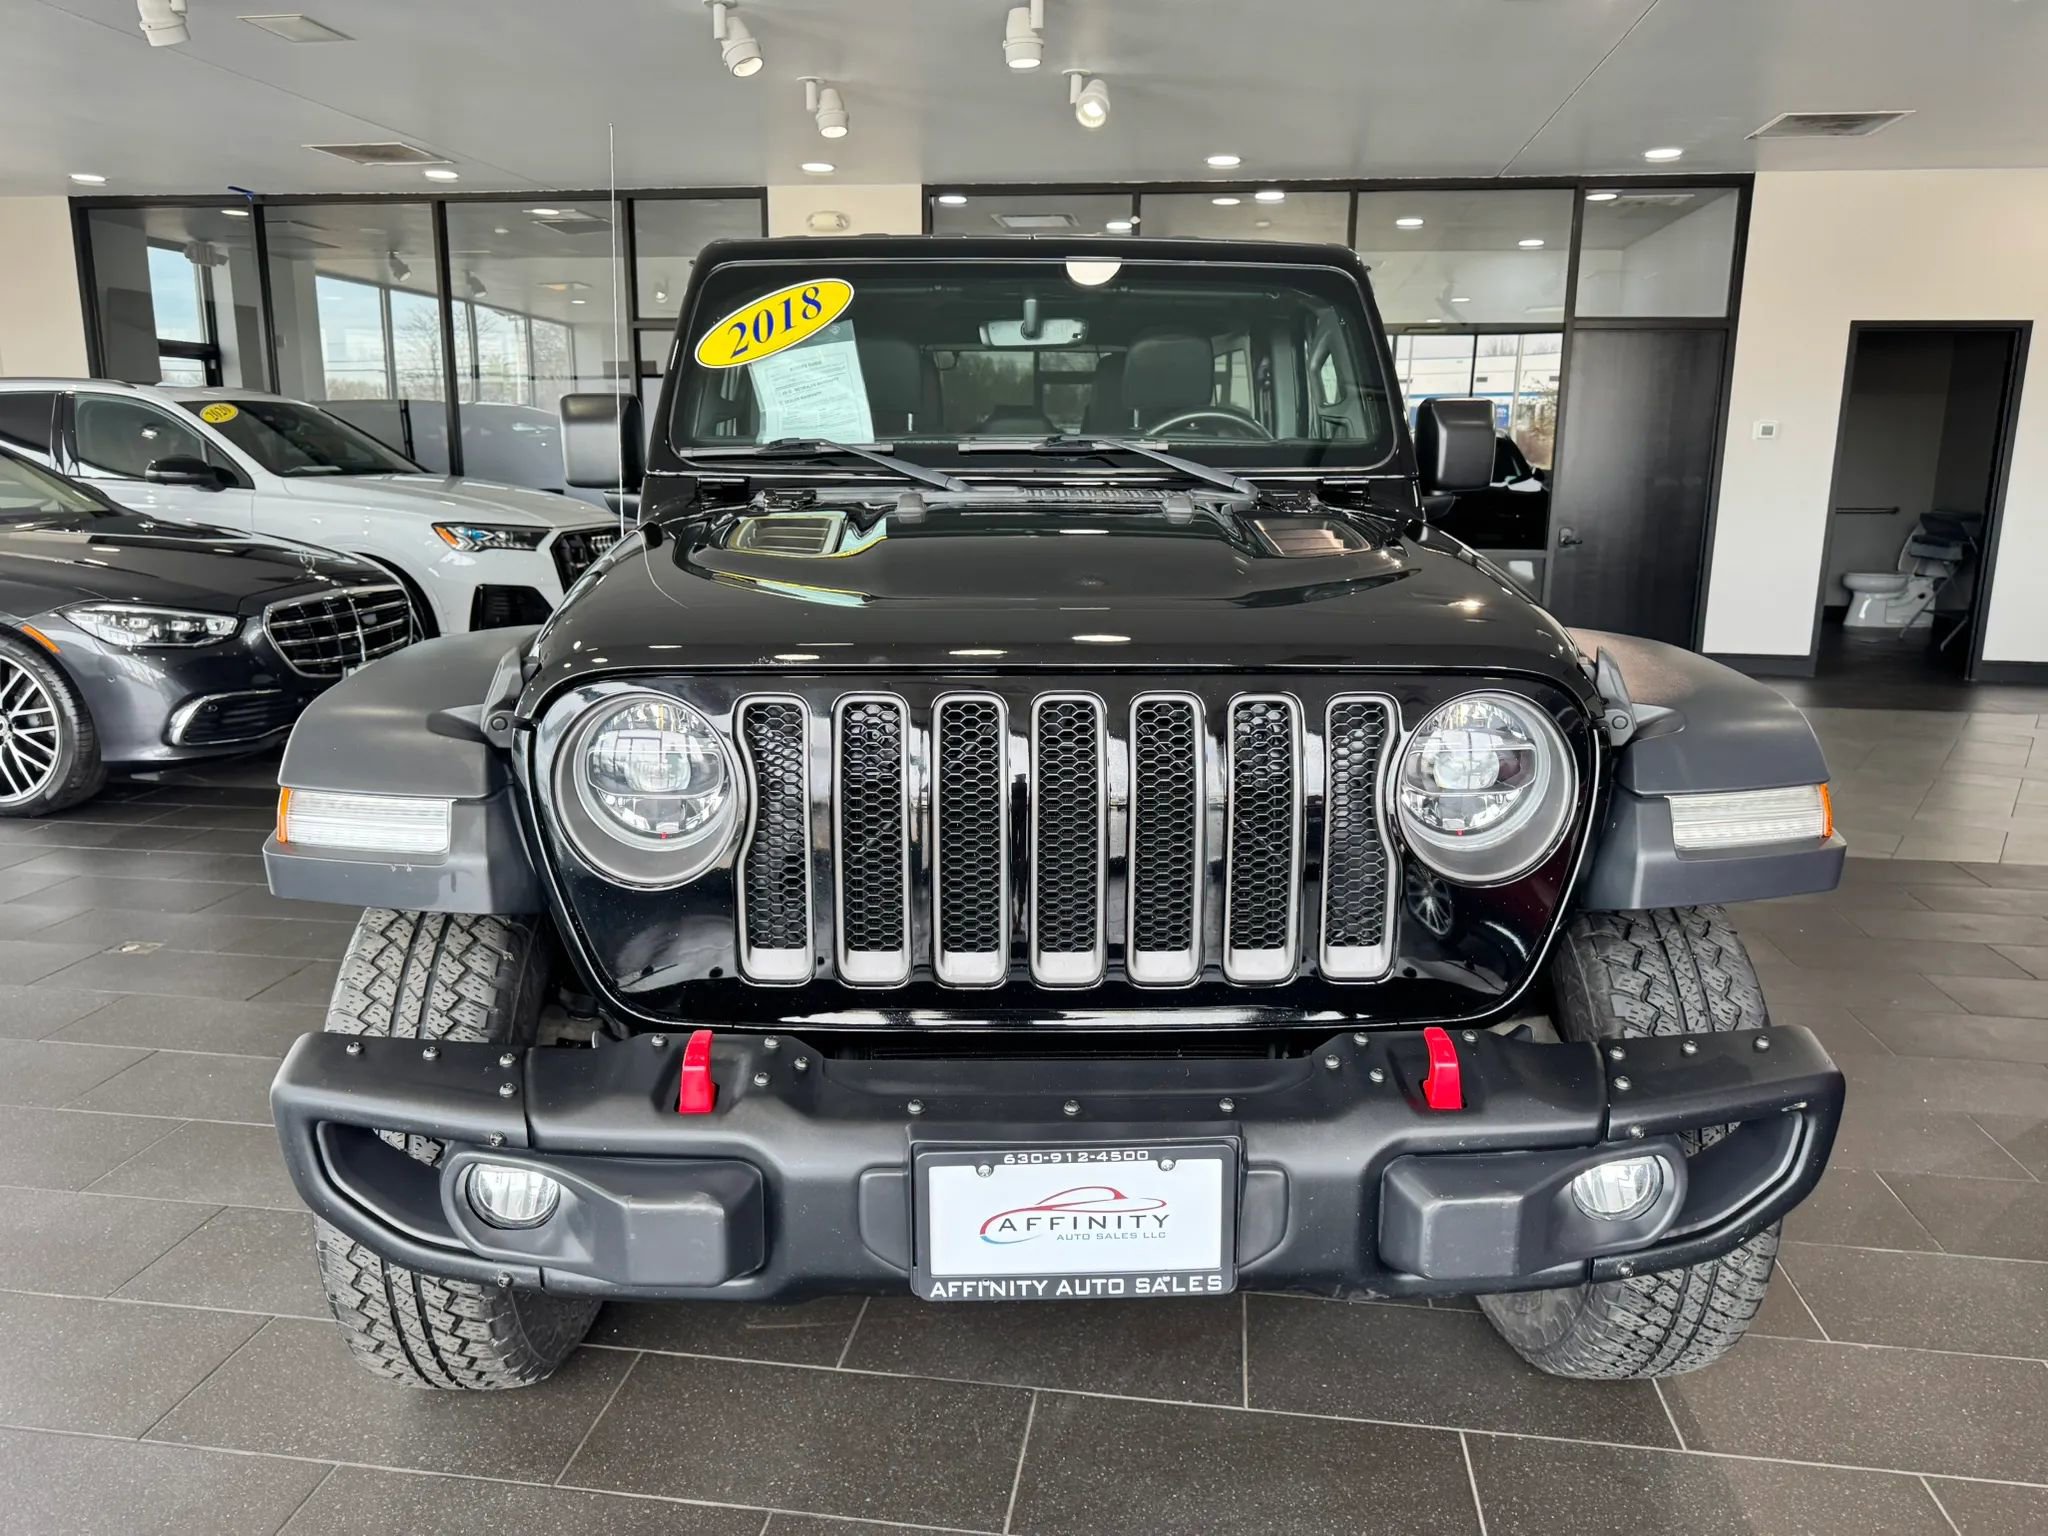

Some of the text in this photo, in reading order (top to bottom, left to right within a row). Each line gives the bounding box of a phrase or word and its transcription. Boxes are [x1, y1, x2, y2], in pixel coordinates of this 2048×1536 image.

[727, 286, 822, 359] 2018
[1003, 1150, 1149, 1164] 630-912-4500
[998, 1214, 1170, 1232] AFFINITY
[1056, 1231, 1167, 1241] AUTO SALES LLC
[930, 1275, 1222, 1298] AFFINITY AUTO SALES
